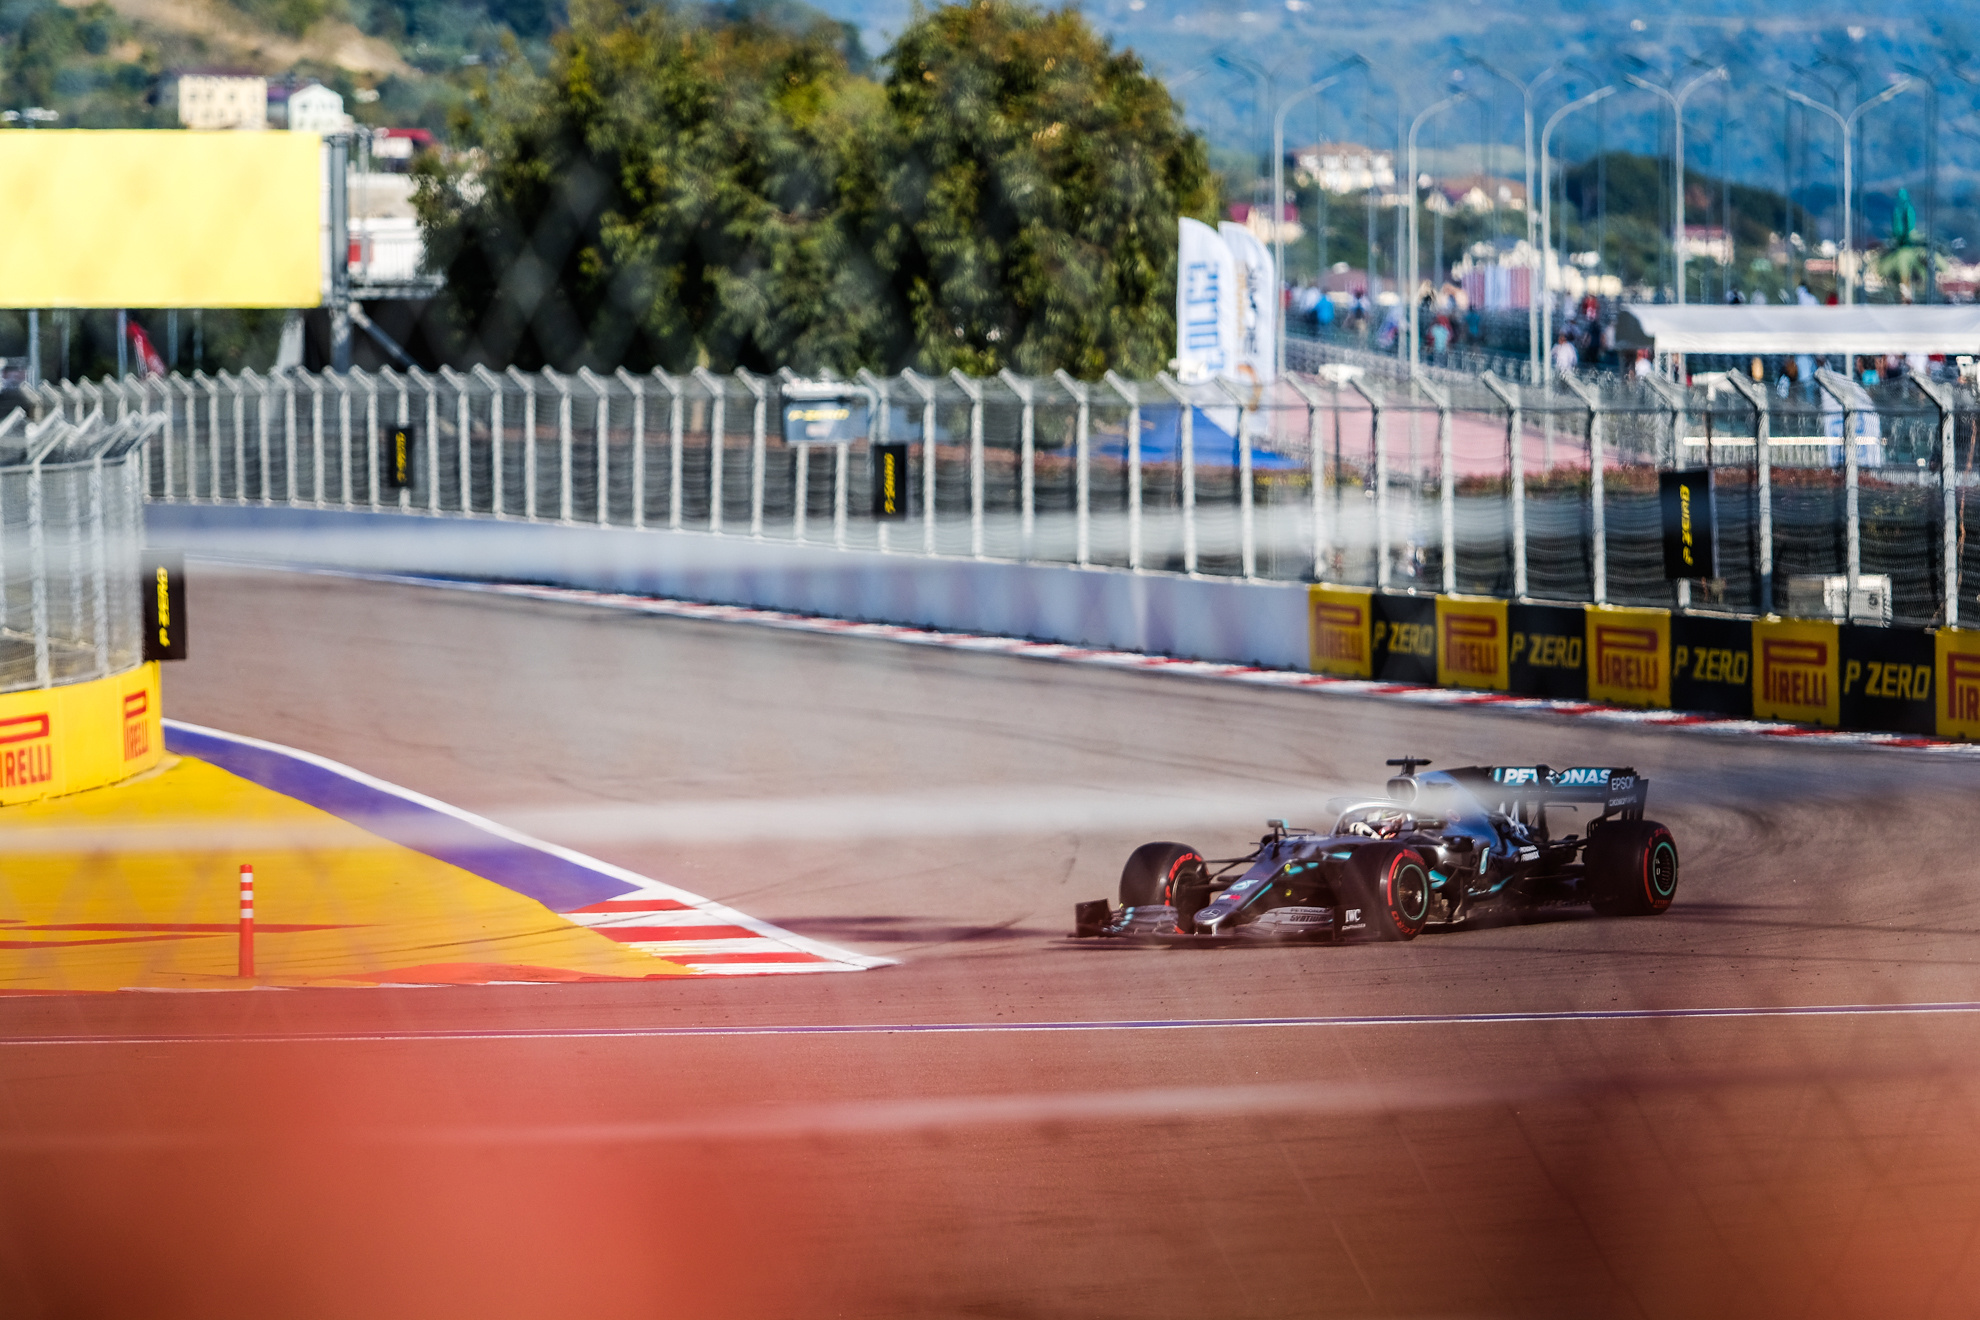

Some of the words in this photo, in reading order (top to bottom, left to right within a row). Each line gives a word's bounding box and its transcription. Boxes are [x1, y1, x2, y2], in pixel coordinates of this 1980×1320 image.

[1315, 602, 1363, 662] PIRELLI
[1373, 620, 1386, 650] P
[1388, 622, 1435, 656] ZERO
[1445, 613, 1498, 675] PIRELLI
[1510, 632, 1526, 663] P
[1528, 634, 1583, 669] ZERO
[1596, 625, 1659, 691] PIRELLI
[1674, 645, 1689, 678] P
[1692, 648, 1749, 685] ZERO
[1762, 638, 1828, 708] PIRELLI
[1844, 659, 1861, 695] P
[1865, 661, 1932, 700] ZERO
[1345, 908, 1361, 923] IWC
